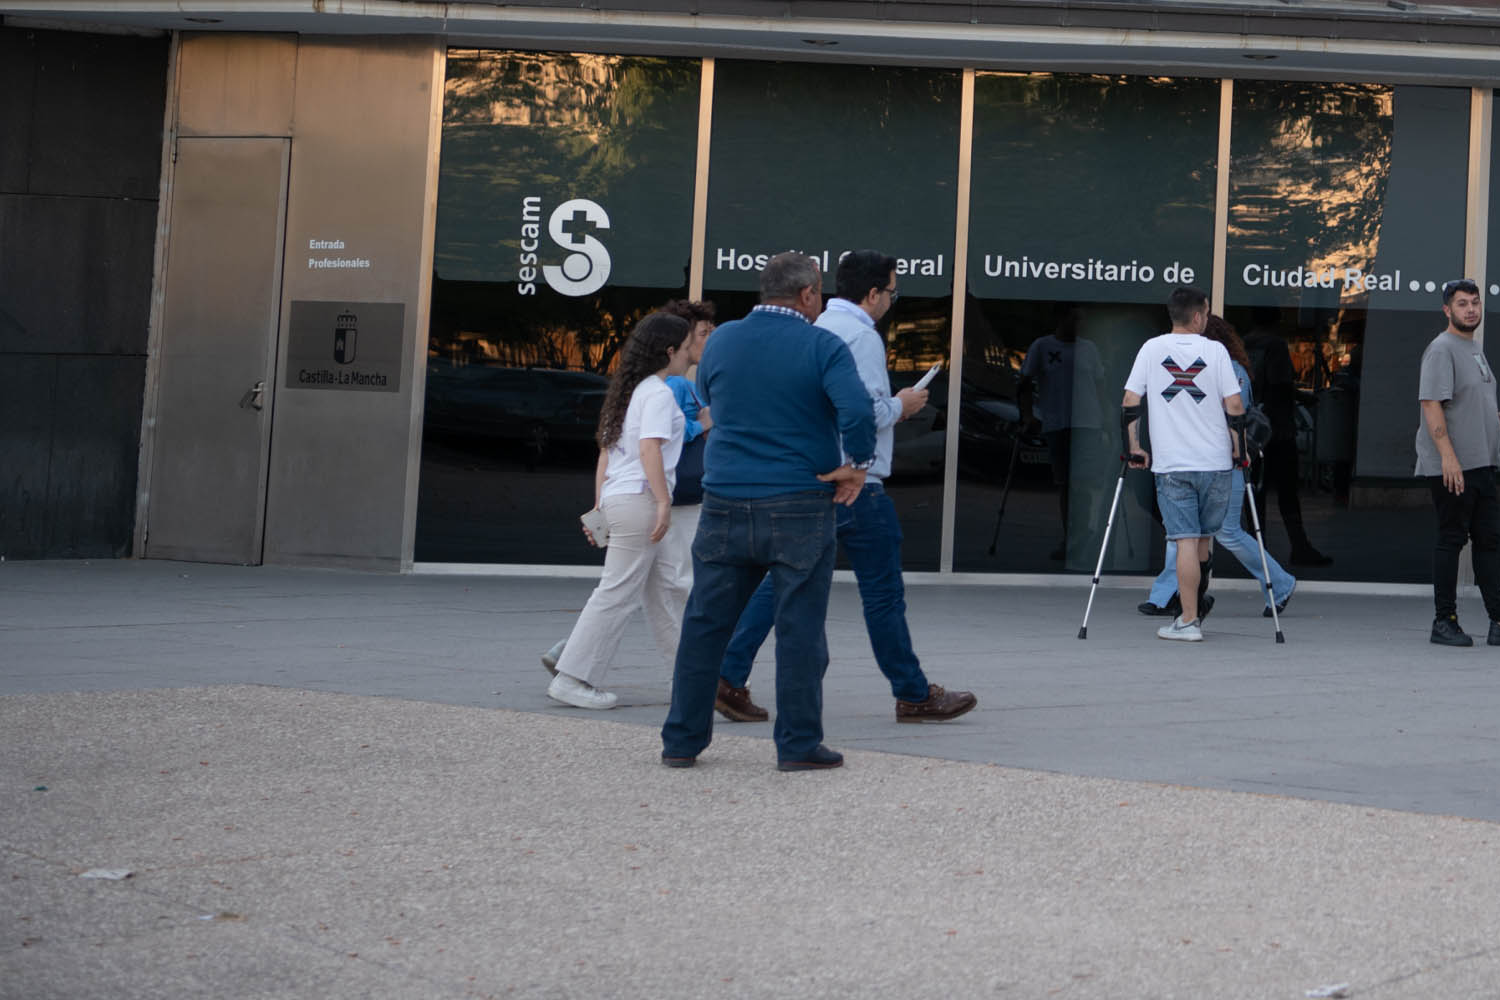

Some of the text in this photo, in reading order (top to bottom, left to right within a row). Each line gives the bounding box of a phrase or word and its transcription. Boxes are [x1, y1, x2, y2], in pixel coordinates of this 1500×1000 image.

[309, 238, 345, 249] Entrada
[518, 195, 541, 296] sescam
[308, 257, 370, 269] Profesionales
[984, 254, 1155, 283] Universitario
[1163, 259, 1195, 285] de
[1242, 262, 1335, 290] Ciudad
[1344, 266, 1401, 292] Real
